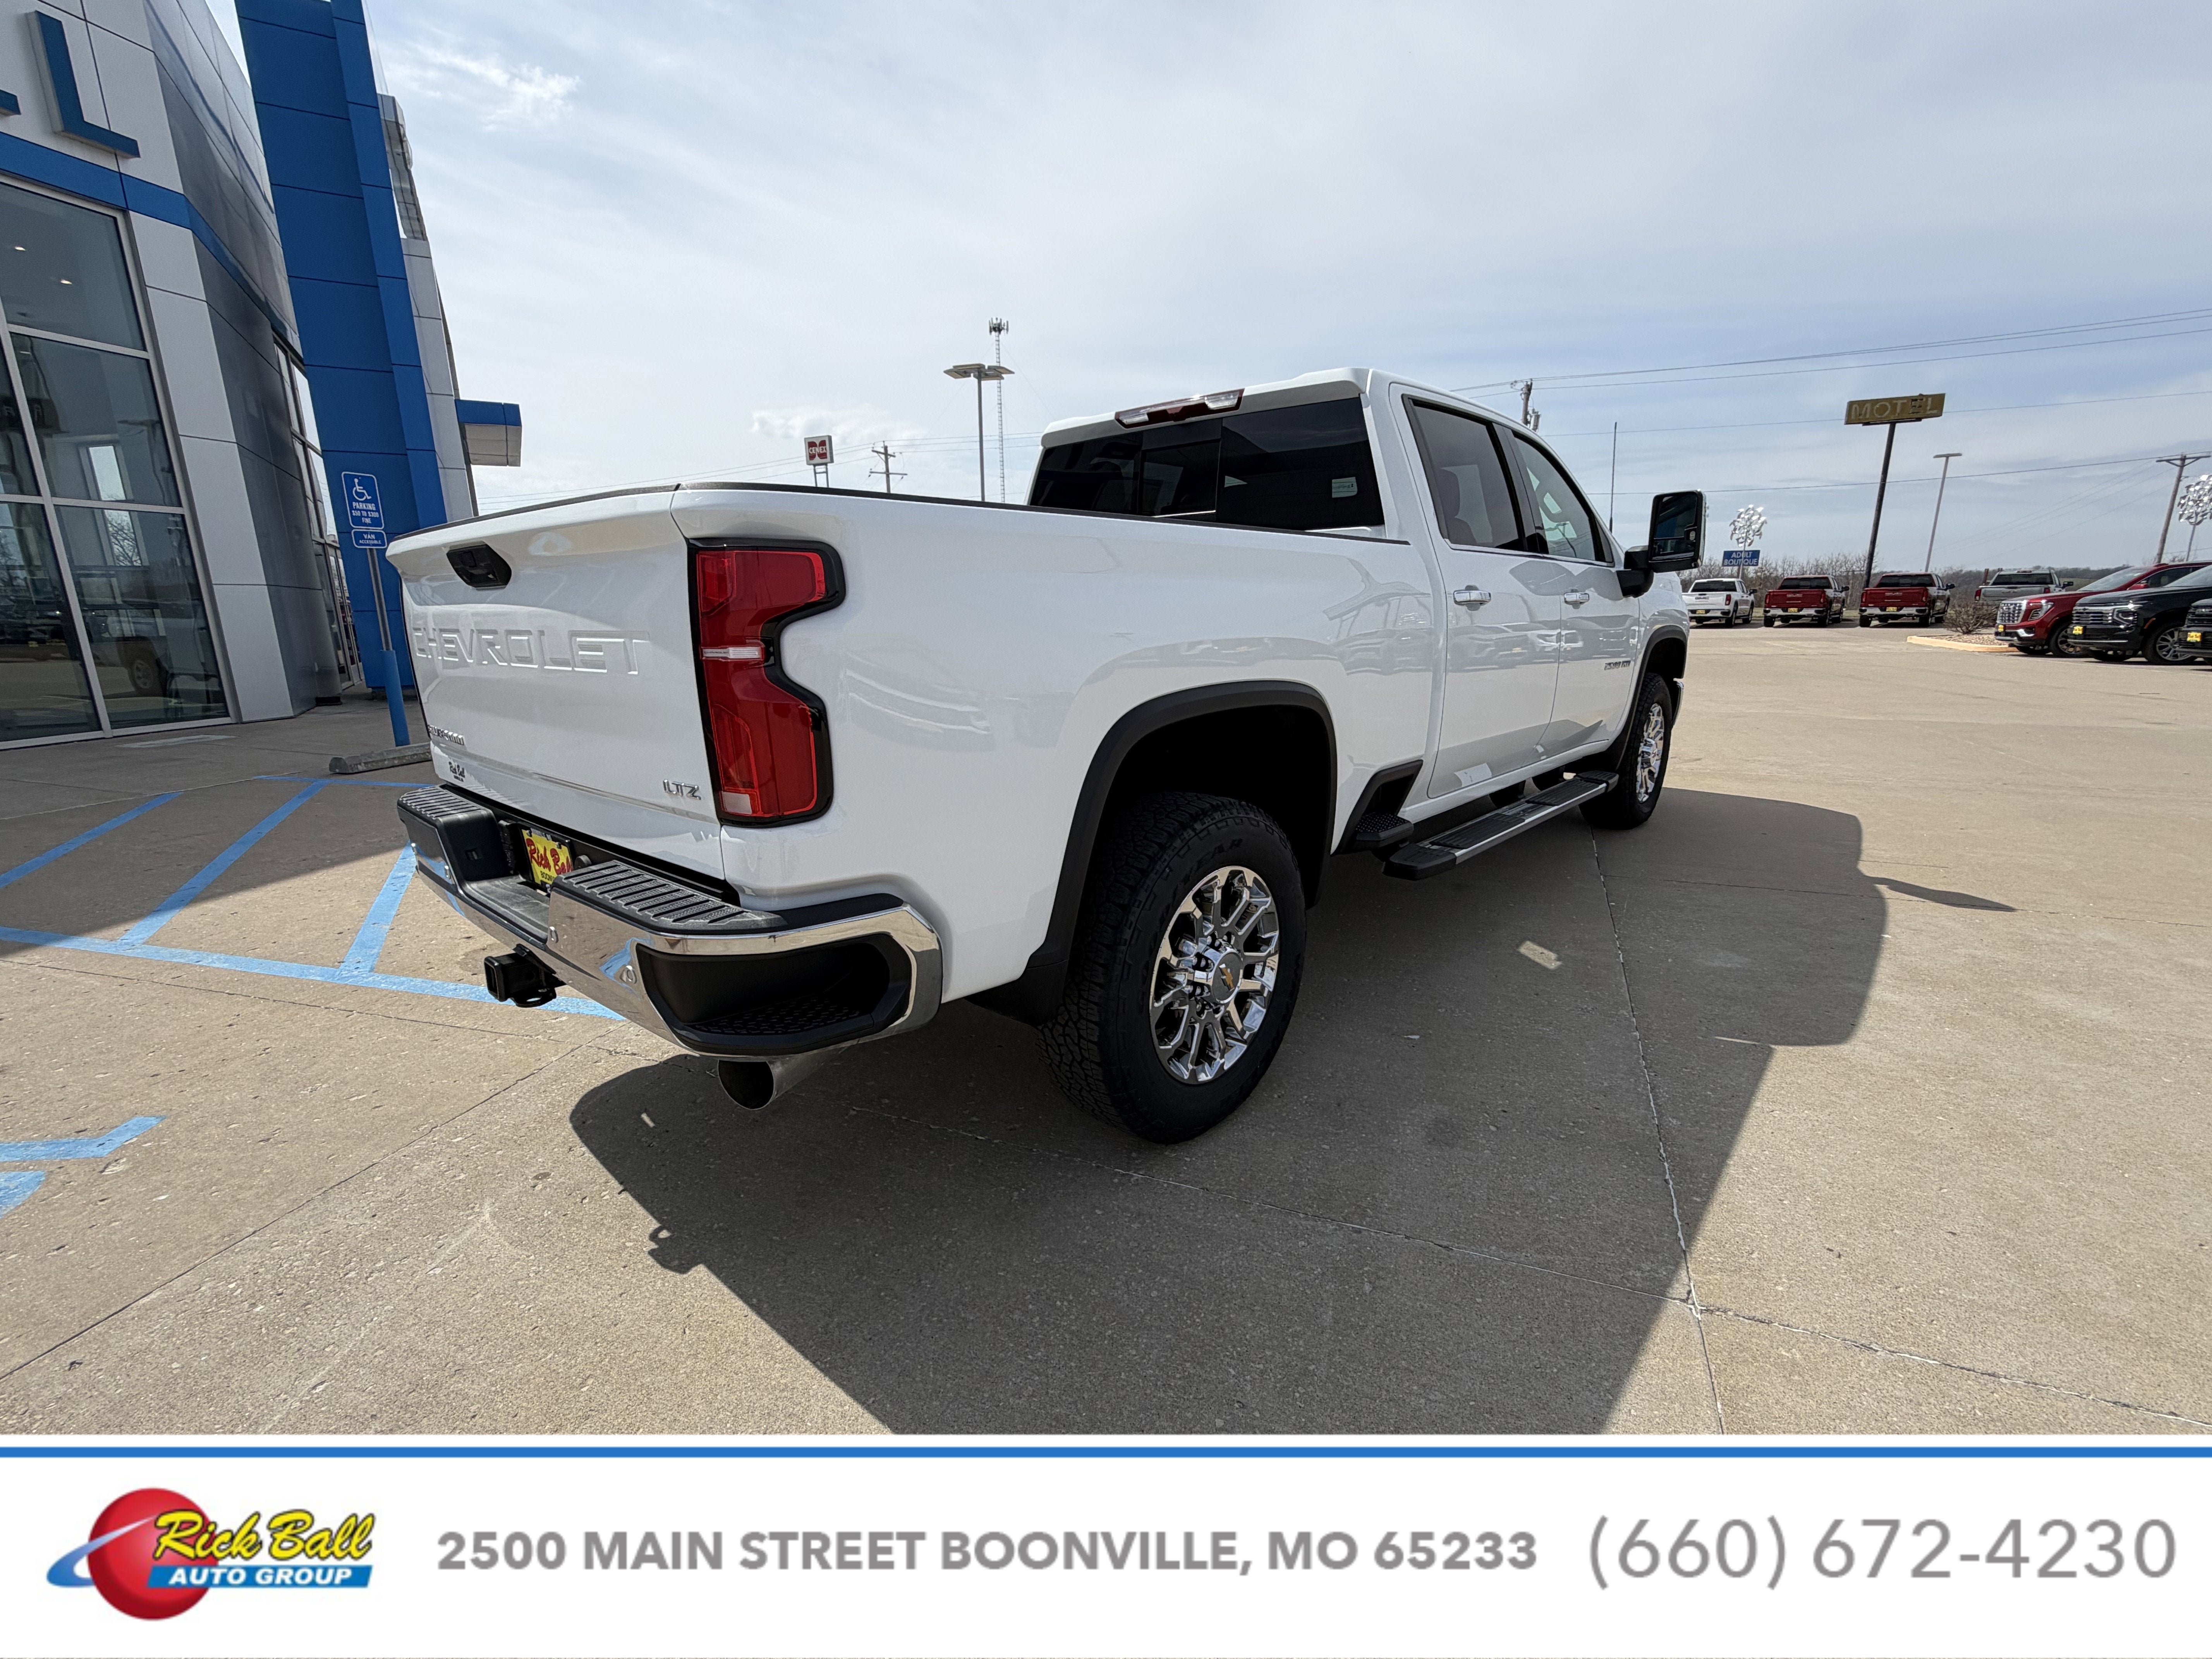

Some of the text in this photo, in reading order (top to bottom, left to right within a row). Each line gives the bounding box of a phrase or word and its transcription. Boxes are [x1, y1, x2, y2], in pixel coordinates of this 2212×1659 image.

[1851, 398, 1938, 419] MOTEL
[809, 446, 827, 454] CENEX
[352, 502, 376, 510] PARKING
[412, 627, 650, 675] CHEVROLET
[663, 779, 702, 800] LTZ
